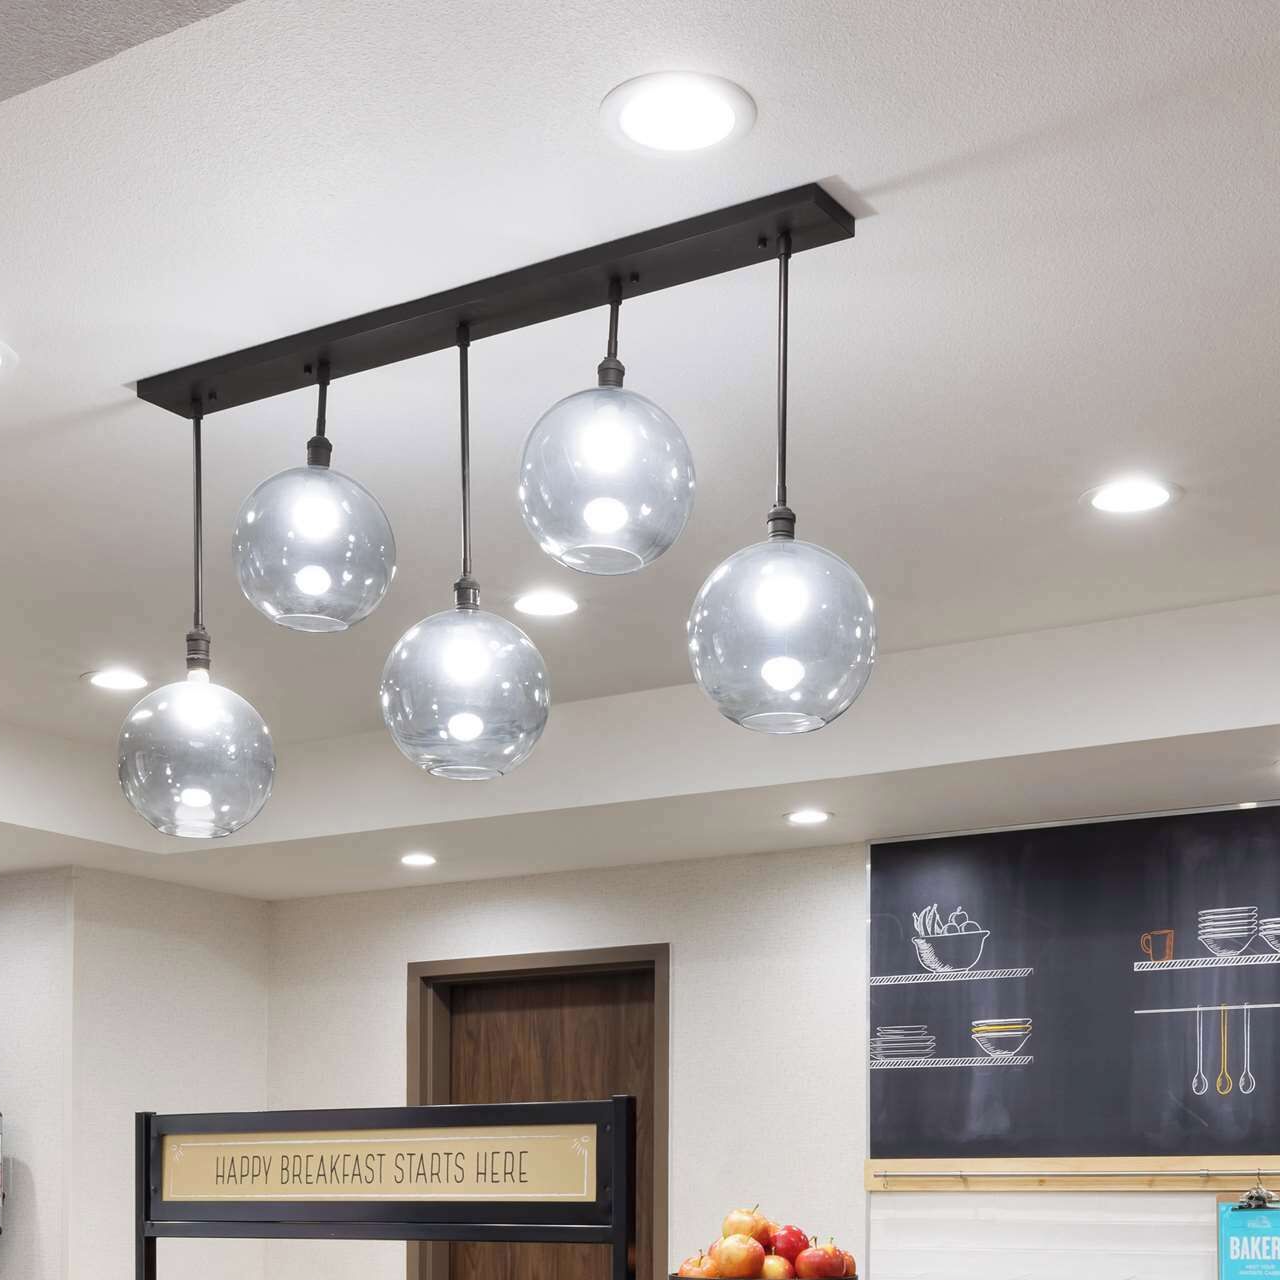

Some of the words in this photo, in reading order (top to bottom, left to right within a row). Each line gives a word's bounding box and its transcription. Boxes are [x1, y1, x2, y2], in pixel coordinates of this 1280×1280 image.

[215, 1154, 272, 1185] HAPPY
[280, 1153, 386, 1185] BREAKFAST
[393, 1152, 465, 1184] STARTS
[476, 1151, 528, 1184] HERE
